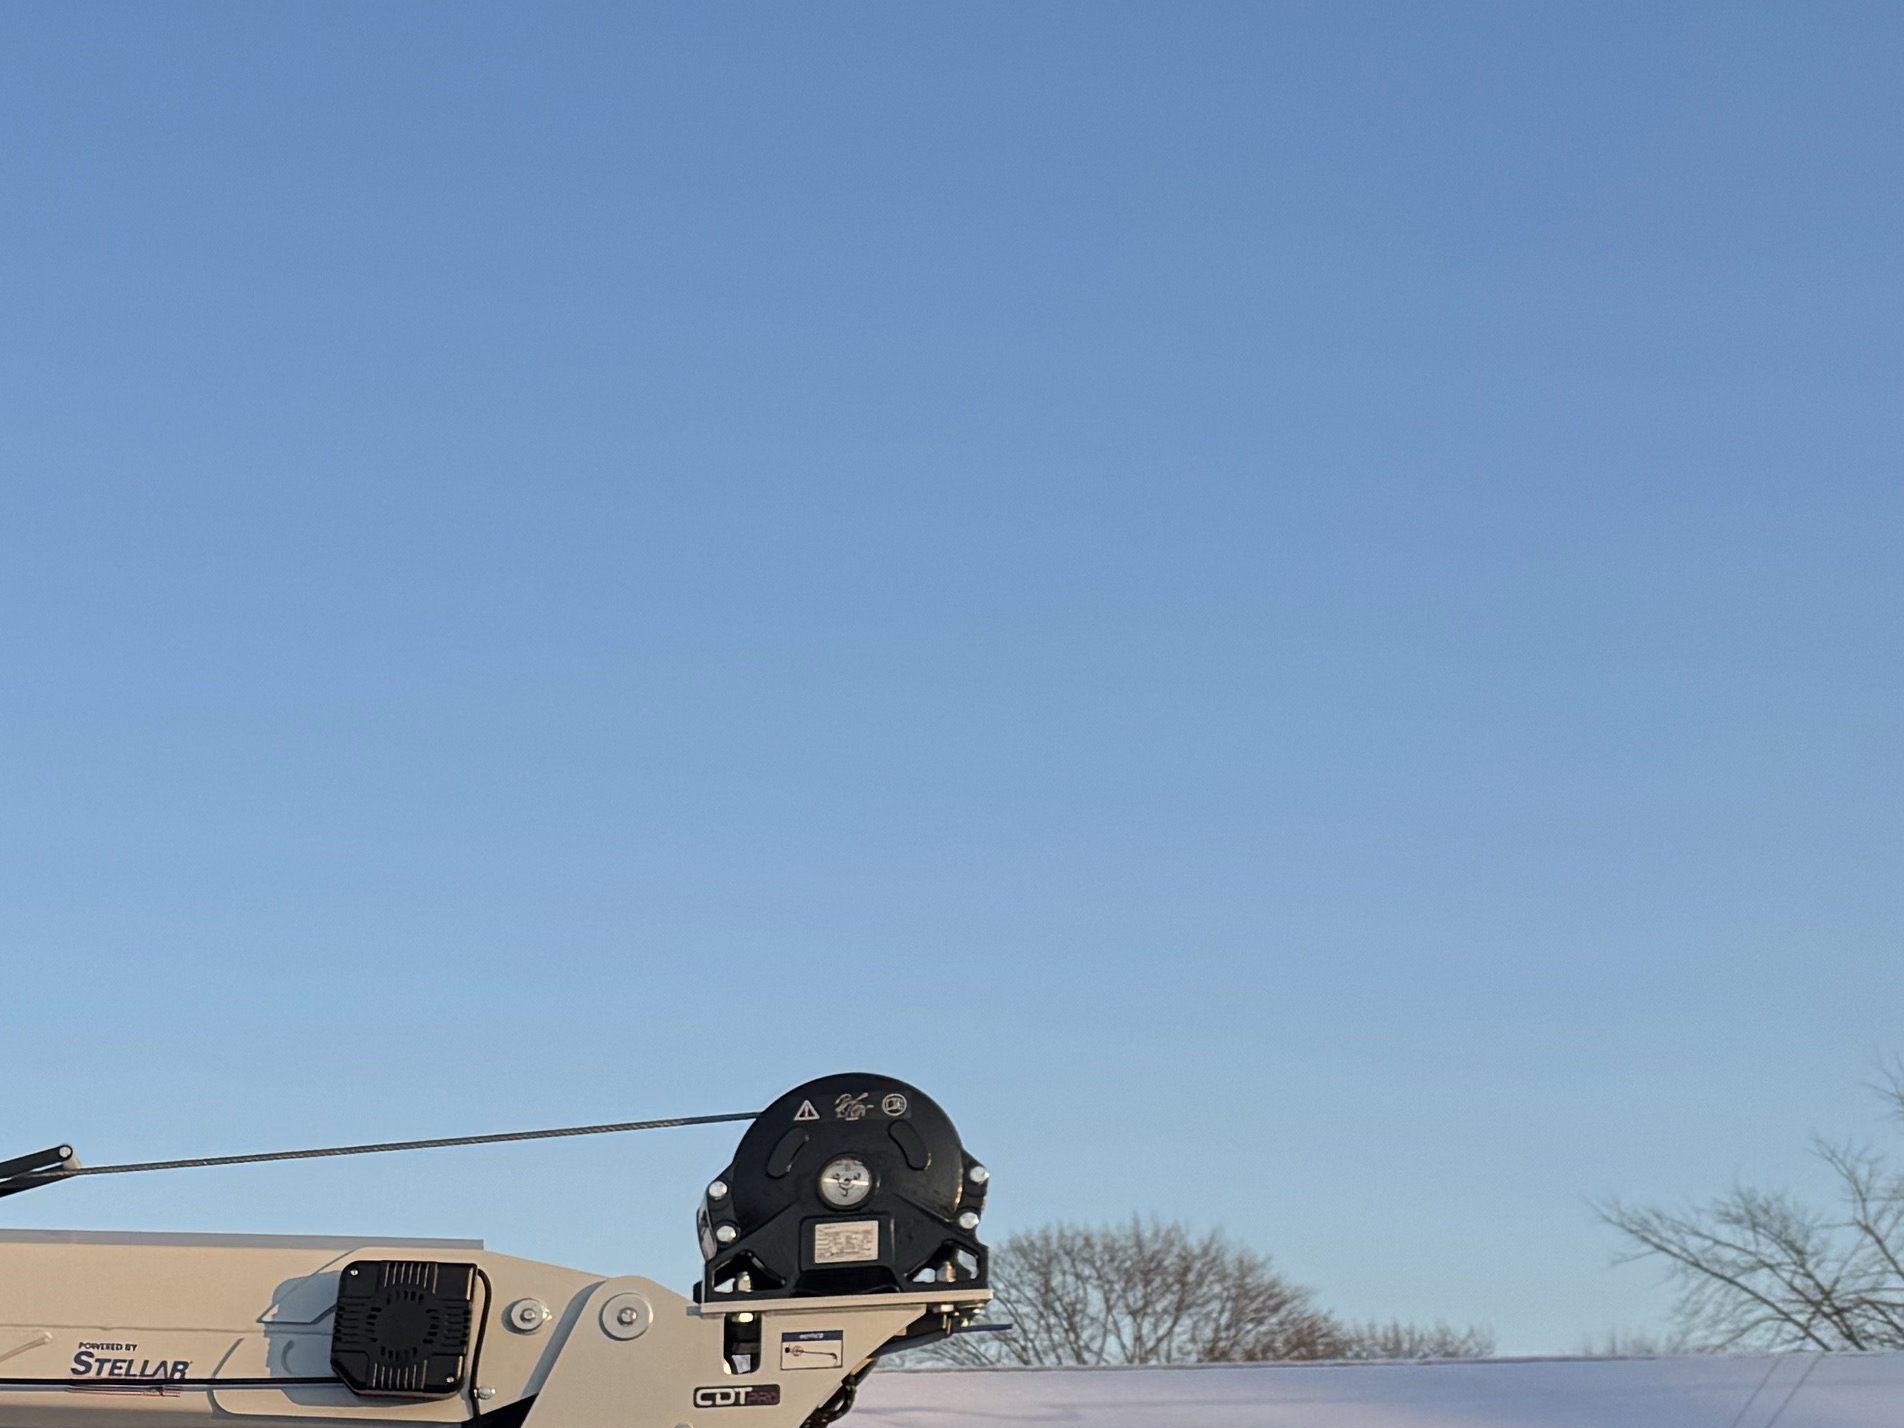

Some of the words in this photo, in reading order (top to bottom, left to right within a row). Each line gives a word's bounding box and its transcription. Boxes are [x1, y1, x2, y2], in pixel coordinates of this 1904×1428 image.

[78, 1342, 123, 1351] POWERED
[124, 1344, 138, 1352] BY
[70, 1351, 190, 1380] STELLAR
